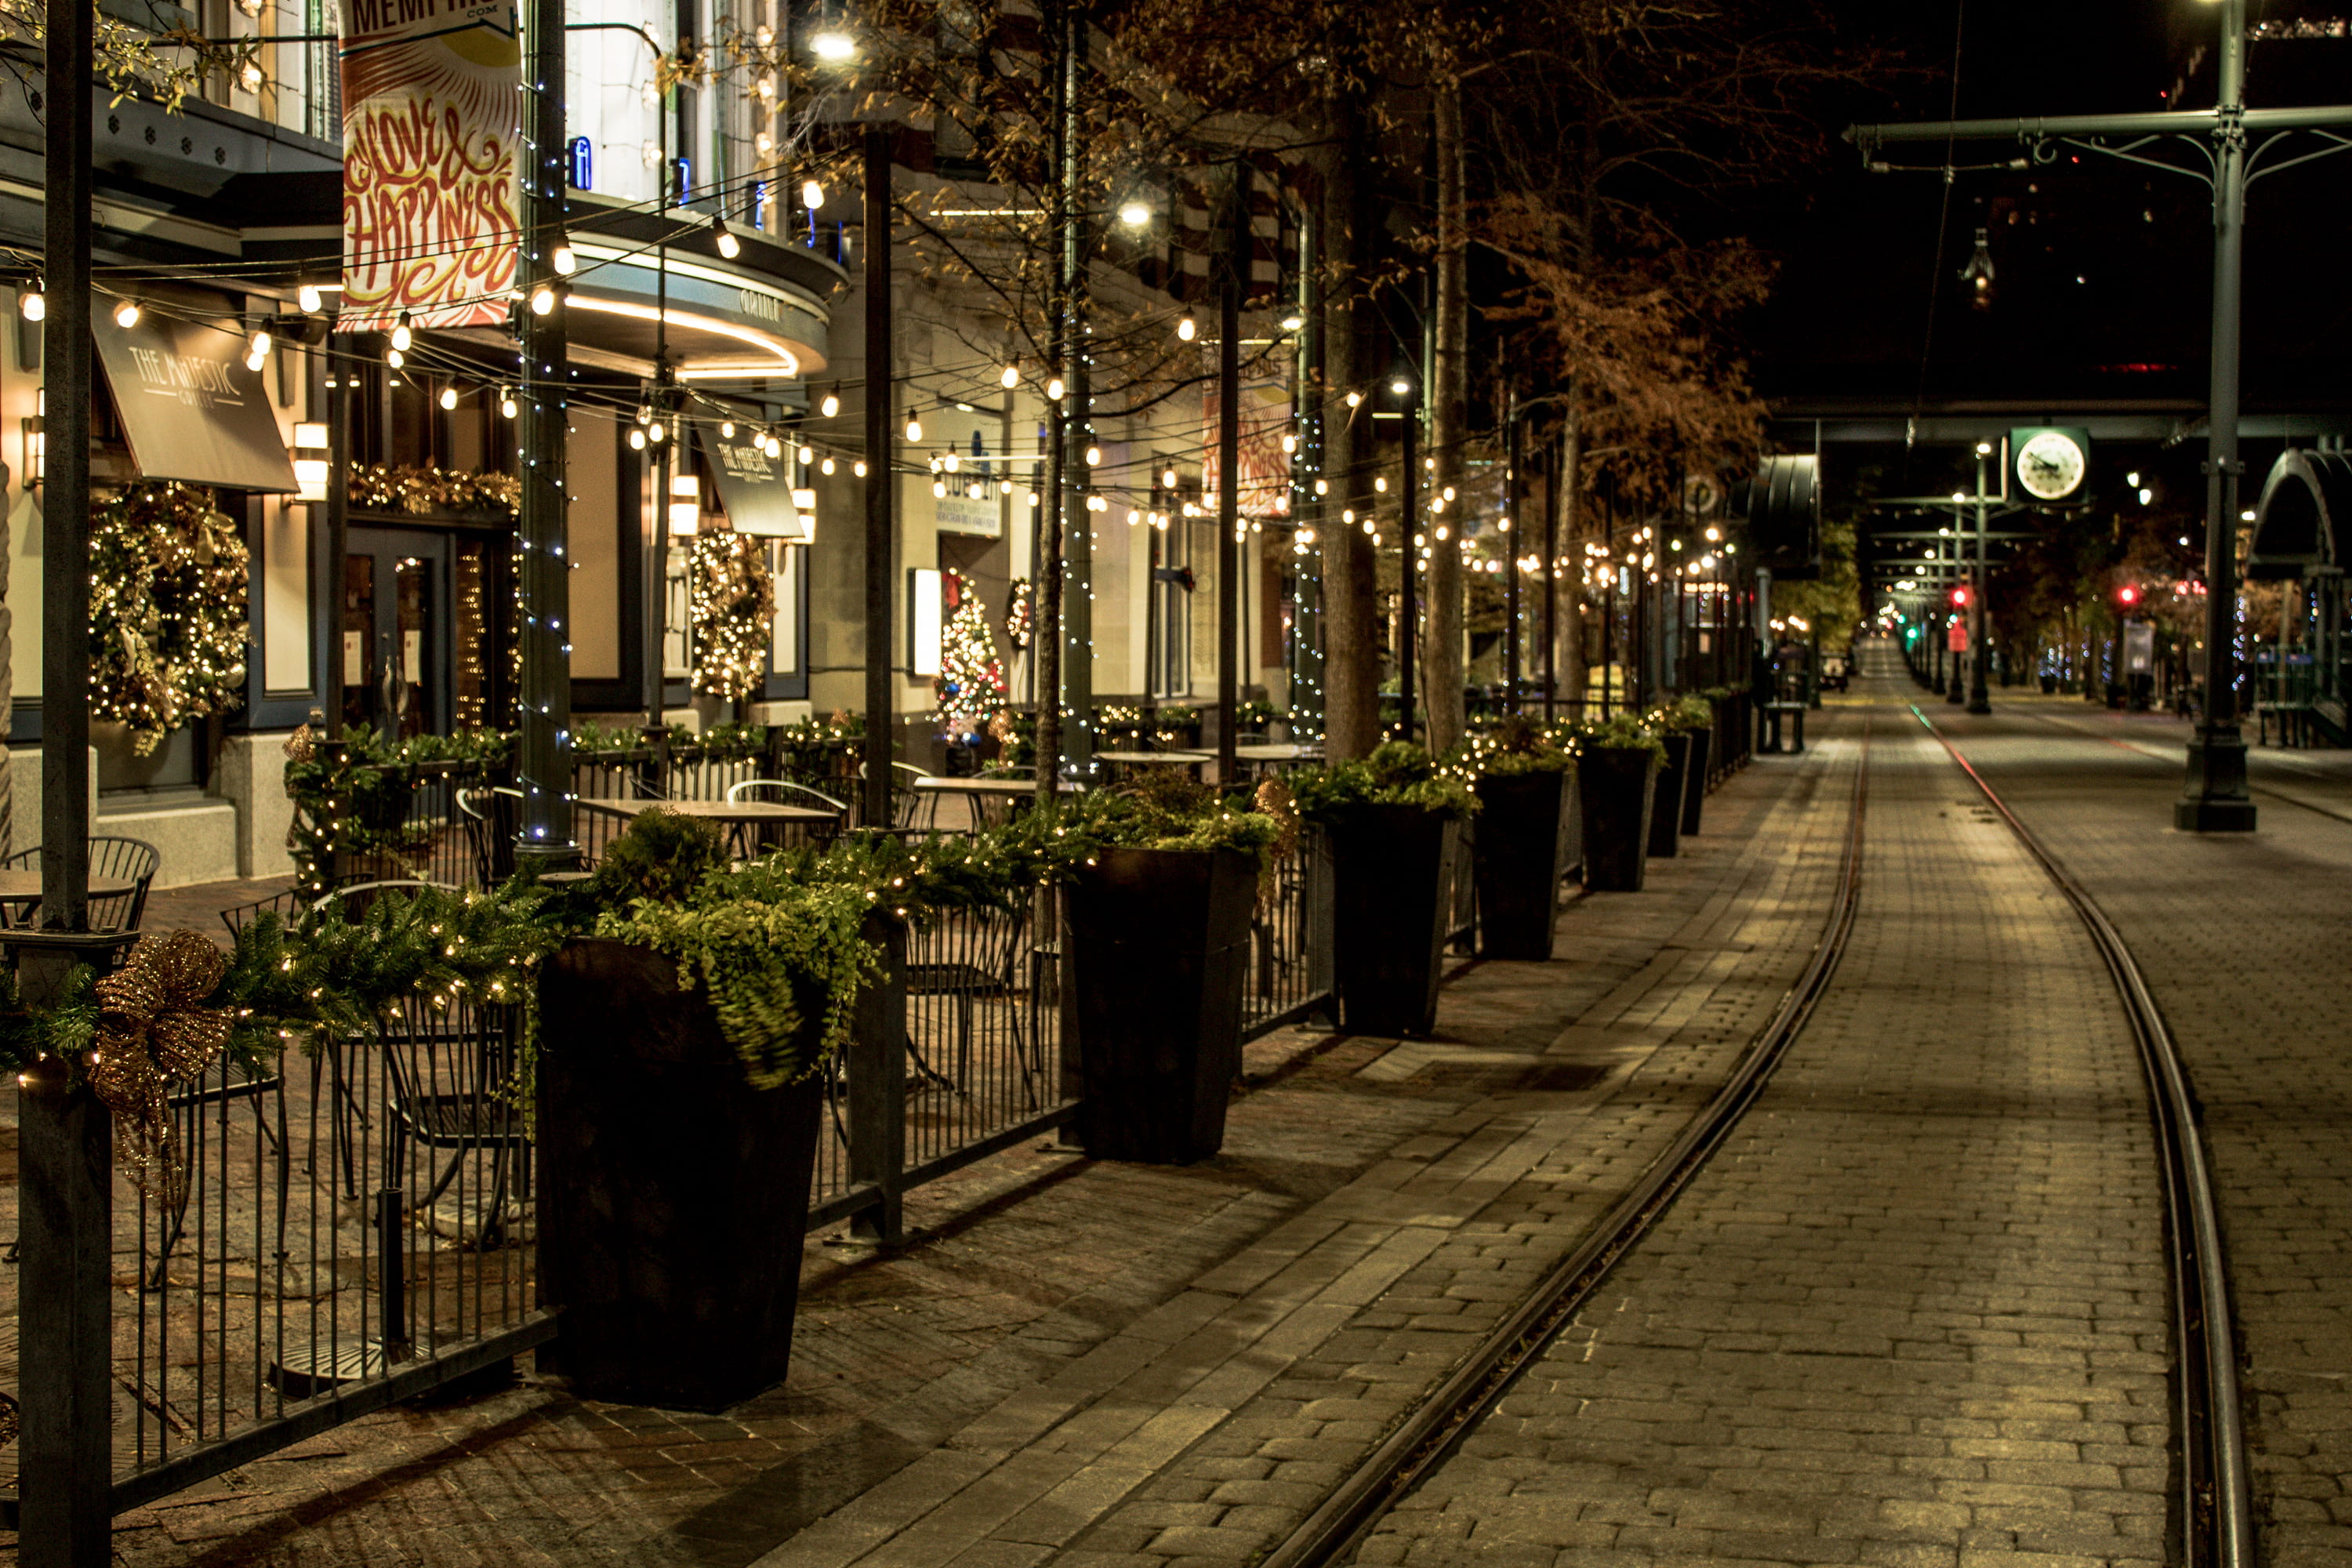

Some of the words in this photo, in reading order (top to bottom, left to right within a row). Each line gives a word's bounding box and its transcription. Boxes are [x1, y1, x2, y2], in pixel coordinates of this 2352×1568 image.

[343, 97, 443, 198] LOVE
[343, 177, 519, 293] HAPPINESS
[129, 347, 167, 385] THE
[165, 354, 241, 396] MAJESTIC
